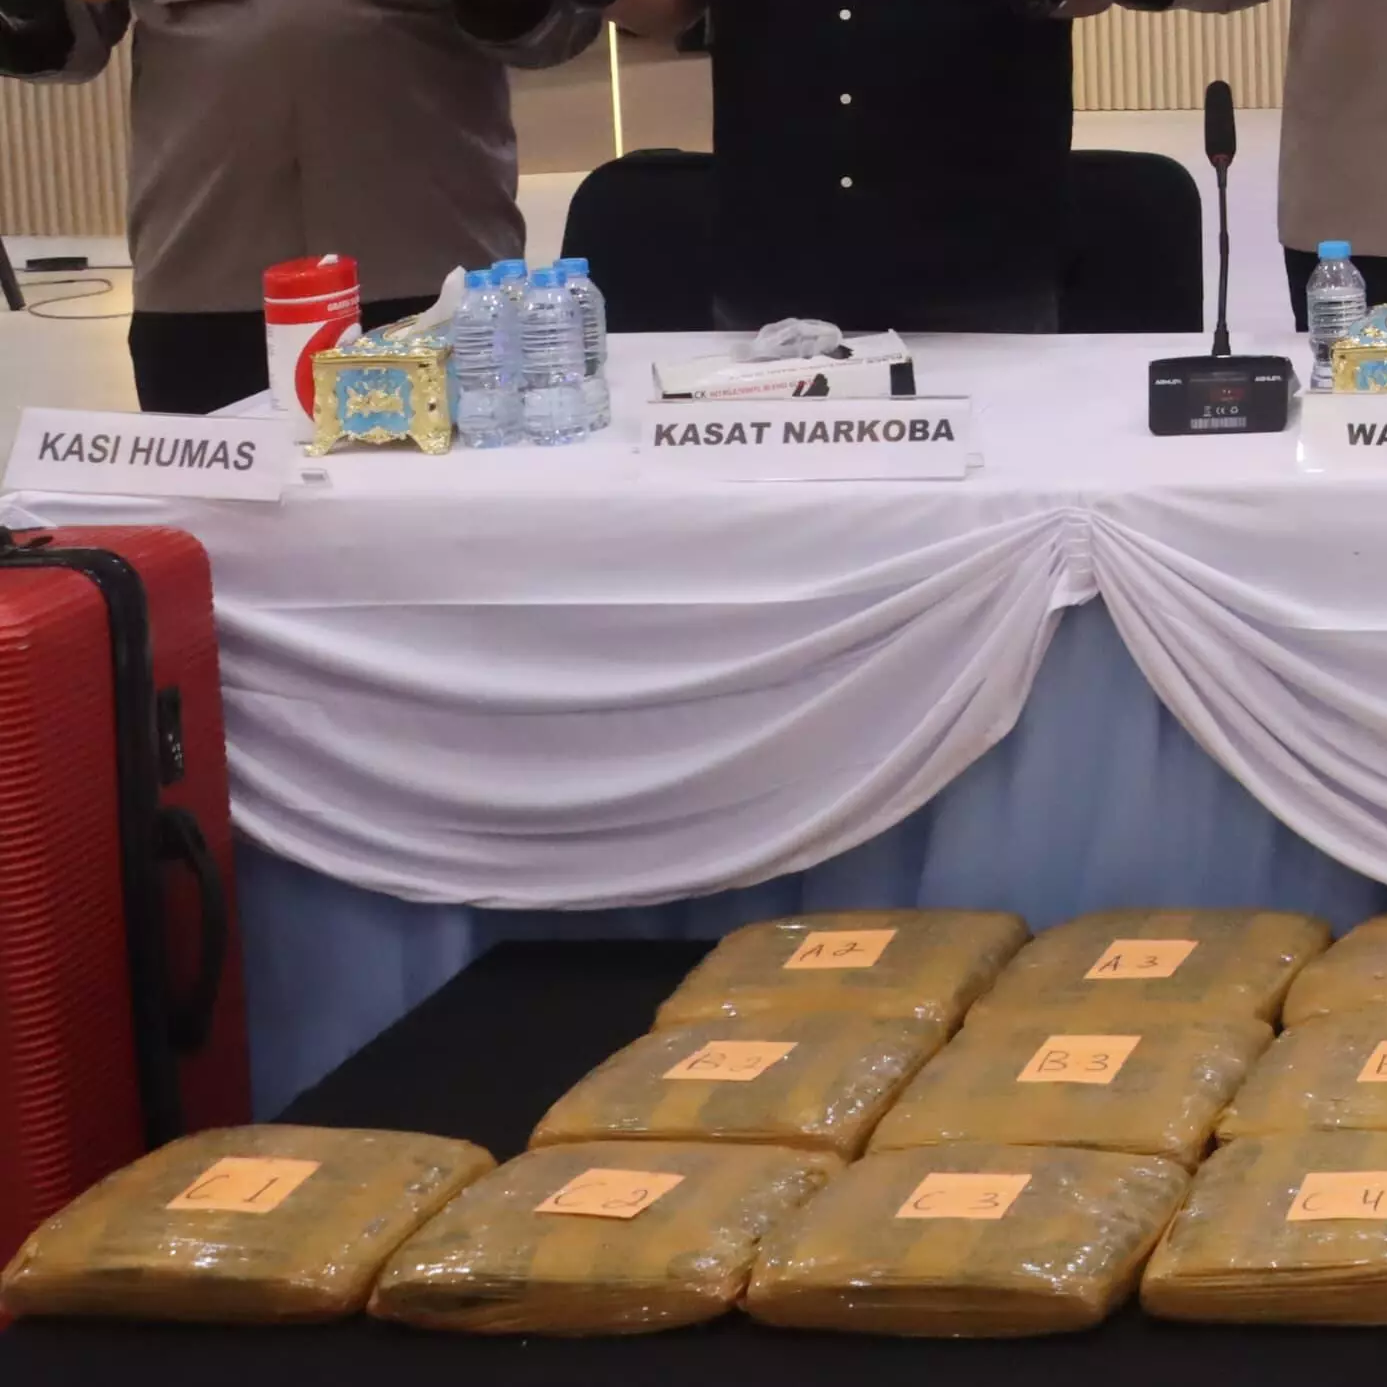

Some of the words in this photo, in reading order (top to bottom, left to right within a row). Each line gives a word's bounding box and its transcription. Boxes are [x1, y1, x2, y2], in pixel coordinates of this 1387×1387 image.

[654, 421, 772, 447] KASAT
[782, 418, 955, 444] NARKOBA
[38, 431, 121, 464] KASI
[129, 436, 256, 471] HUMAS
